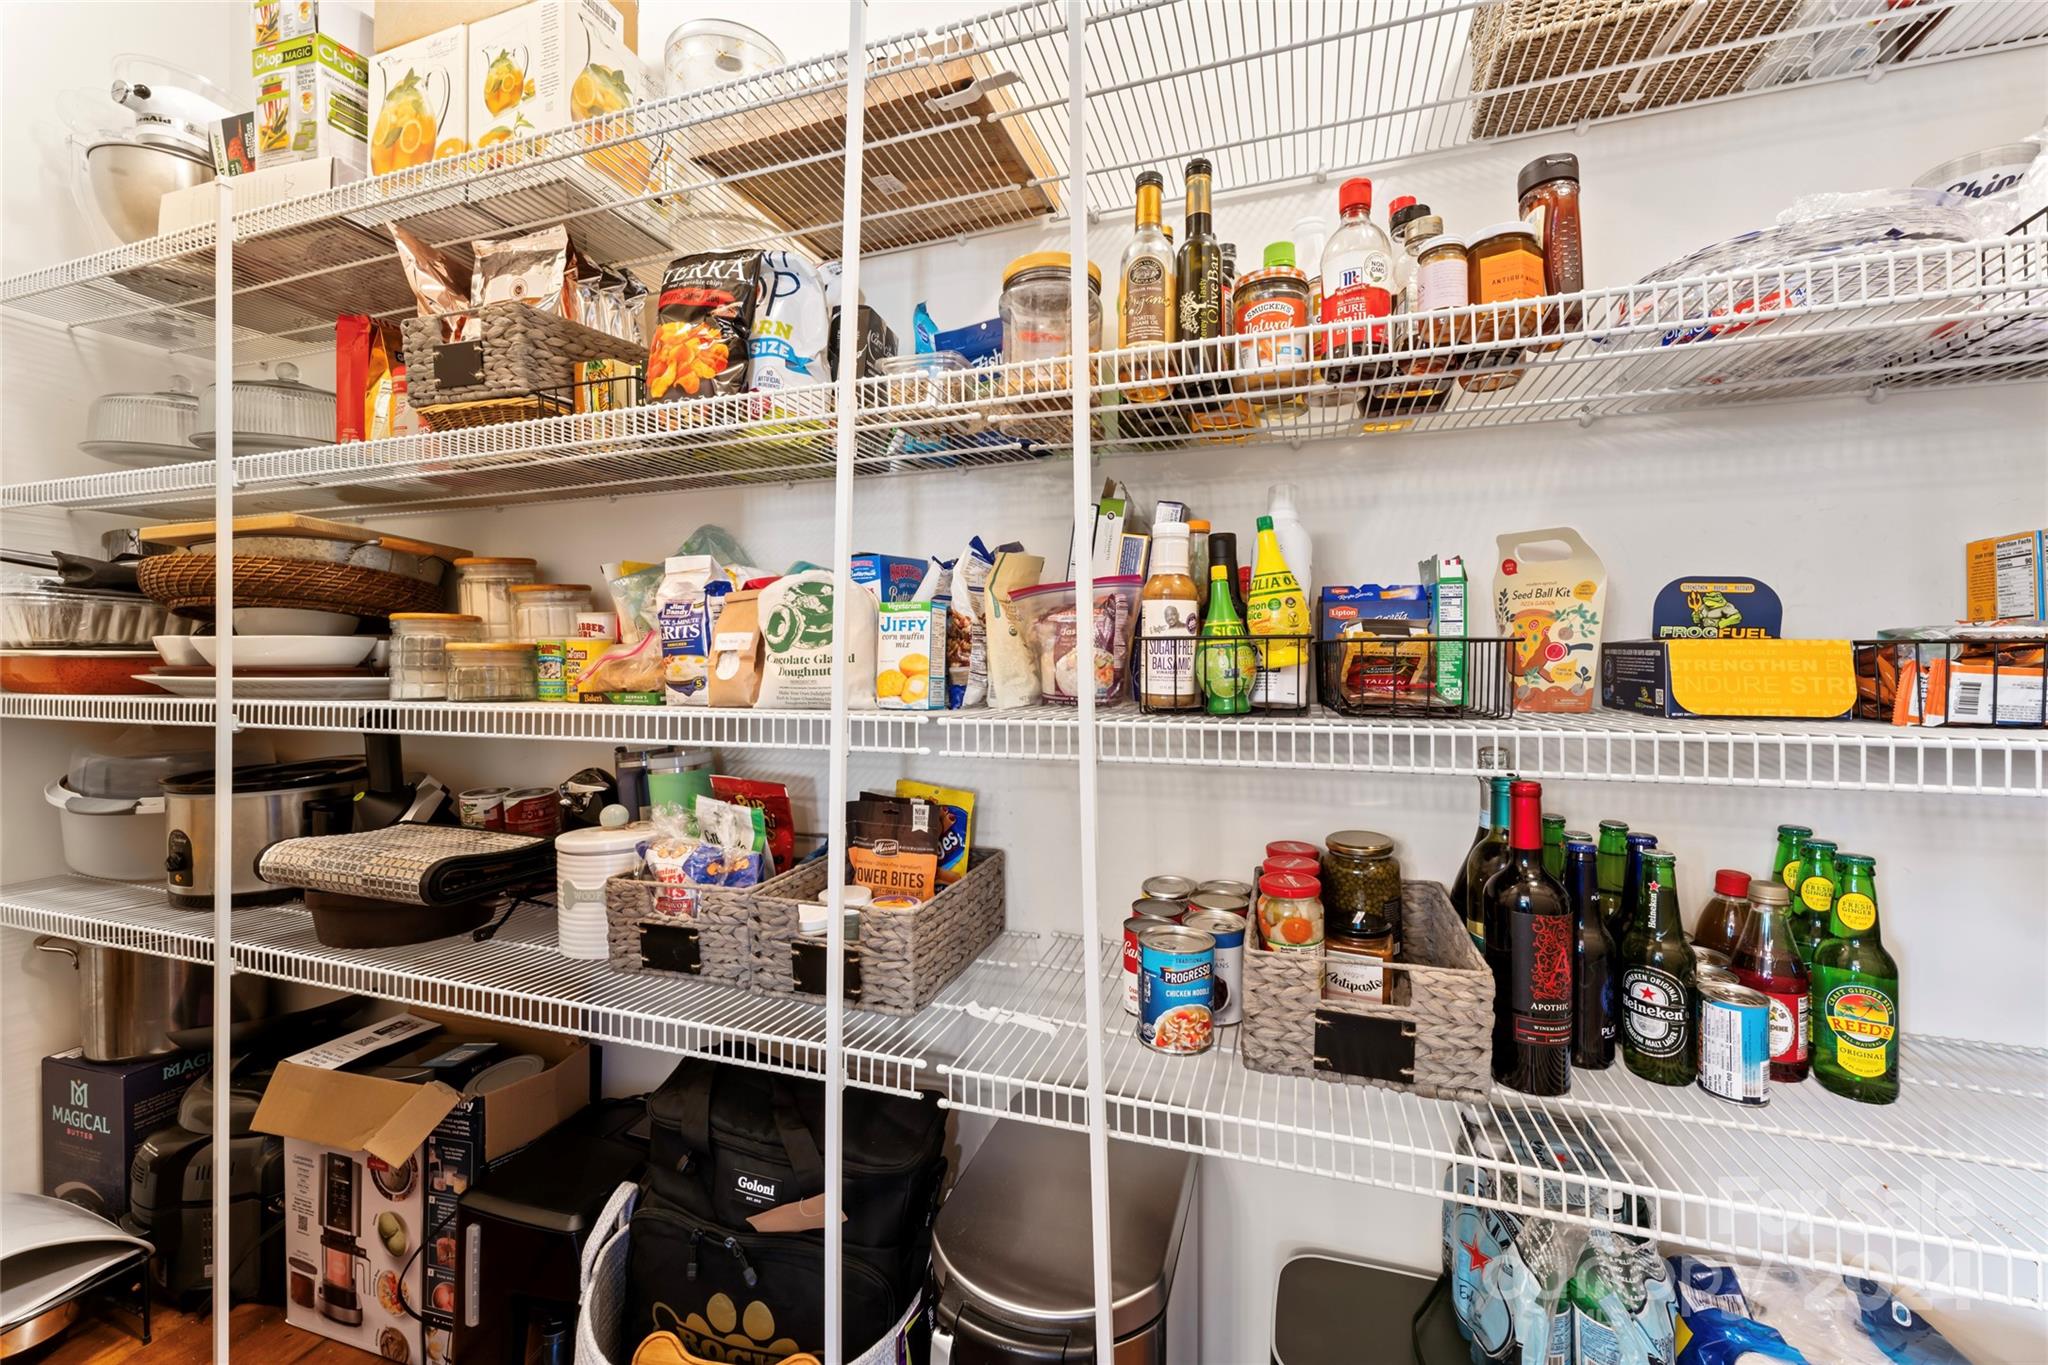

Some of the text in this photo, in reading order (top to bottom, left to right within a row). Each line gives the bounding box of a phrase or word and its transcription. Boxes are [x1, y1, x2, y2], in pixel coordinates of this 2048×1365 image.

[255, 46, 313, 70] Chop MAGIC
[319, 44, 366, 82] Chop
[1371, 260, 1385, 268] NON
[663, 257, 747, 286] TERRA
[1337, 302, 1367, 316] PURE
[751, 340, 790, 358] SIZE
[1512, 589, 1534, 600] Seed
[1535, 587, 1553, 599] Ball
[1555, 586, 1571, 598] Kit
[1331, 609, 1357, 618] Lipton
[880, 616, 928, 632] JIFFY
[881, 632, 925, 641] corn muffin
[895, 640, 911, 649] mix
[1151, 656, 1192, 670] BALSAMIC
[1671, 659, 1818, 673] STRENGTHEN
[857, 867, 925, 889] OWER BITES
[1842, 900, 1872, 910] FRESH
[1842, 906, 1872, 916] GINGER
[1165, 964, 1211, 984] PROGRESSO
[1166, 989, 1191, 998] CHICKEN
[1650, 976, 1679, 1002] ORIGINAL
[1848, 987, 1882, 1000] GINGER
[1530, 1002, 1569, 1012] APOTHIC
[1623, 993, 1685, 1021] Heineken
[1831, 1017, 1892, 1036] REED'S
[1840, 1046, 1884, 1060] ORIGINAL
[52, 1105, 111, 1134] MAGICAL
[66, 1127, 94, 1140] BUTTER
[737, 1176, 775, 1196] Goloni
